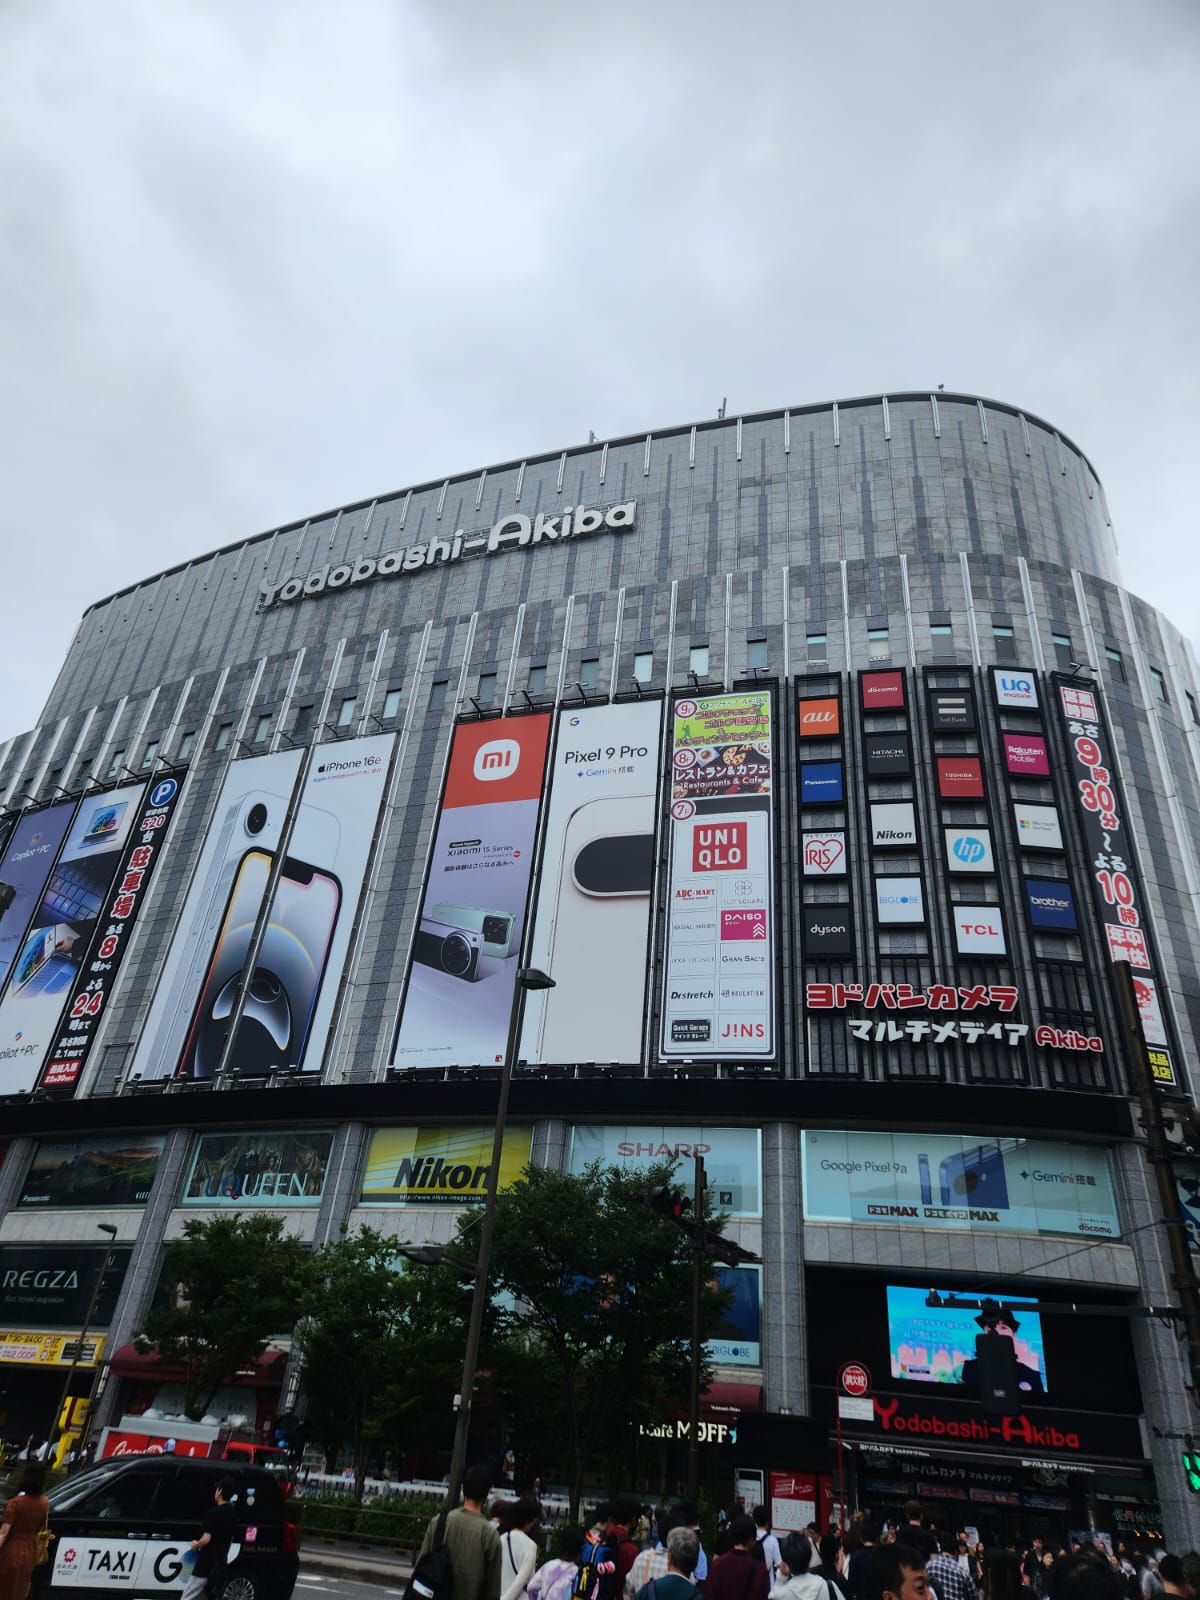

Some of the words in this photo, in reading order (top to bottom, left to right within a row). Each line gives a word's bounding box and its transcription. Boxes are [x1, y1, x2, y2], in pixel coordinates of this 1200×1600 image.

[259, 503, 636, 606] Yodobashi-Akiba
[1001, 678, 1031, 694] UQ
[803, 712, 835, 723] au
[1068, 721, 1099, 738] あさ
[565, 748, 601, 765] Pixel
[605, 747, 616, 760] 9
[620, 745, 648, 759] Pro
[1008, 746, 1044, 755] Rakuten
[1009, 755, 1036, 763] Mobile
[326, 760, 361, 772] iPhone
[363, 756, 382, 766] 16e
[675, 763, 768, 781] レストラン&カフェ
[140, 815, 166, 831] 520
[699, 828, 738, 846] UNI
[876, 830, 912, 839] Nikon
[698, 847, 742, 868] QLO
[805, 849, 831, 865] IRIS
[957, 840, 983, 860] hp
[1094, 853, 1127, 872] よる
[110, 844, 153, 919] 駐車場
[1096, 870, 1134, 906] 10
[1030, 896, 1070, 908] brother
[725, 913, 762, 921] DAISO
[810, 924, 846, 936] dyson
[960, 924, 999, 936] TCL
[98, 934, 119, 959] 8
[70, 990, 104, 1018] 24
[806, 983, 1018, 1011] ヨドバシカメラ
[848, 1019, 1029, 1046] マルチメディア
[1035, 1025, 1104, 1052] Akiba
[617, 1142, 711, 1158] SHARP
[820, 1159, 862, 1175] Google
[864, 1161, 890, 1173] Pixel
[893, 1163, 907, 1173] 9a
[1032, 1170, 1074, 1184] Gemini
[1078, 1223, 1112, 1234] docomo
[2, 1270, 79, 1289] REGZA
[872, 1396, 1080, 1449] Yodobashi-Akiba
[88, 1550, 136, 1572] TAXI
